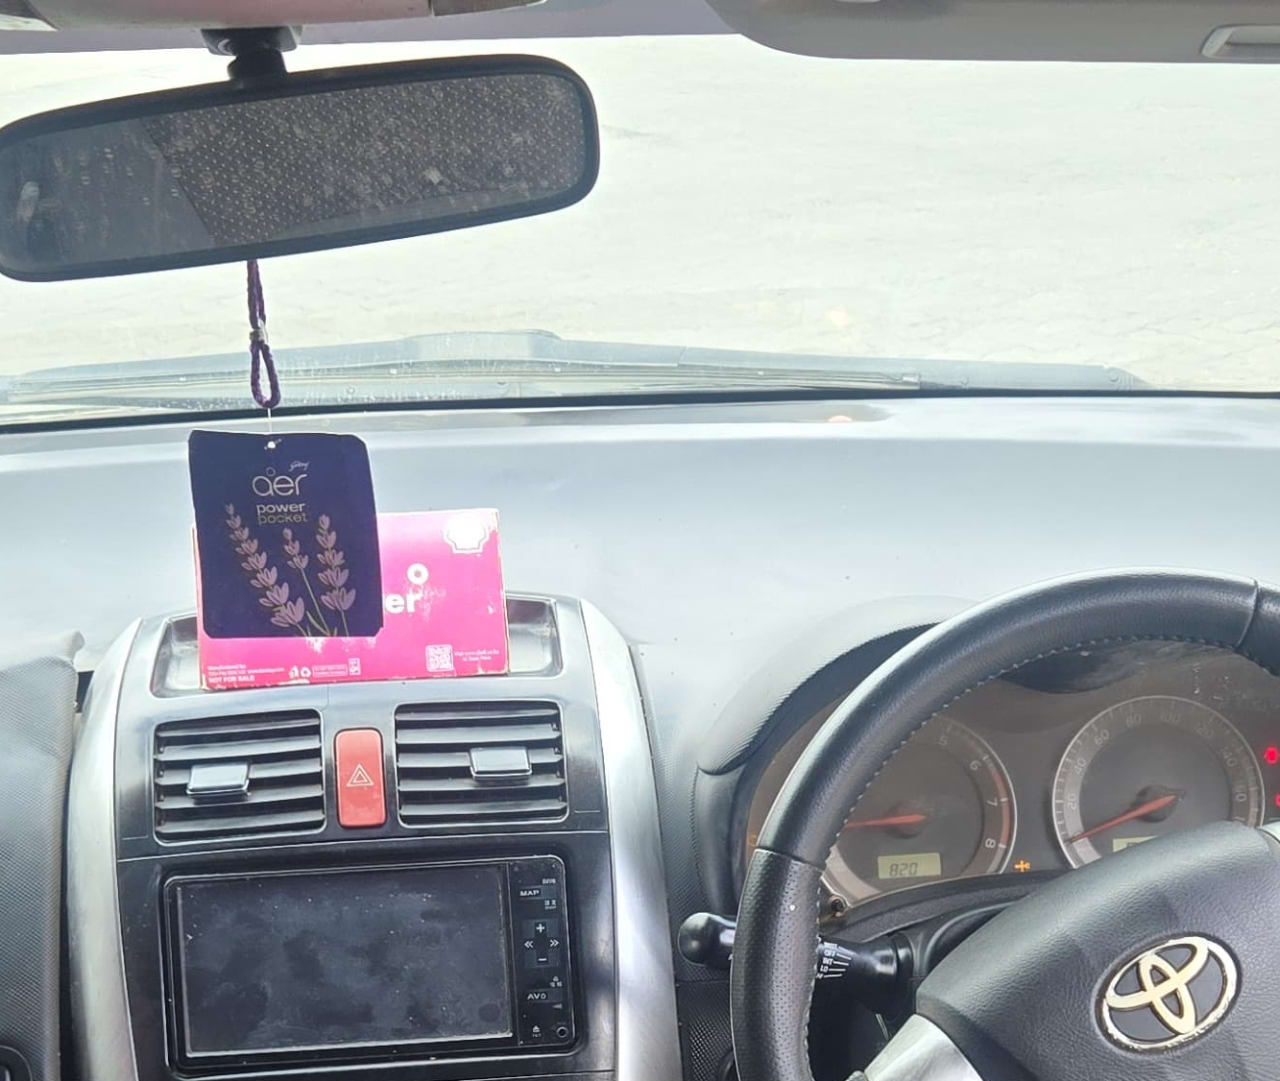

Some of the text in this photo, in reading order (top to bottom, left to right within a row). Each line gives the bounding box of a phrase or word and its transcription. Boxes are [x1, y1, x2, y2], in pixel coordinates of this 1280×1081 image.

[252, 473, 308, 496] aer
[257, 503, 306, 515] power
[258, 513, 308, 525] pocket
[1094, 730, 1110, 746] 60
[986, 797, 998, 807] 7
[985, 837, 996, 849] 8
[519, 889, 540, 897] MAP
